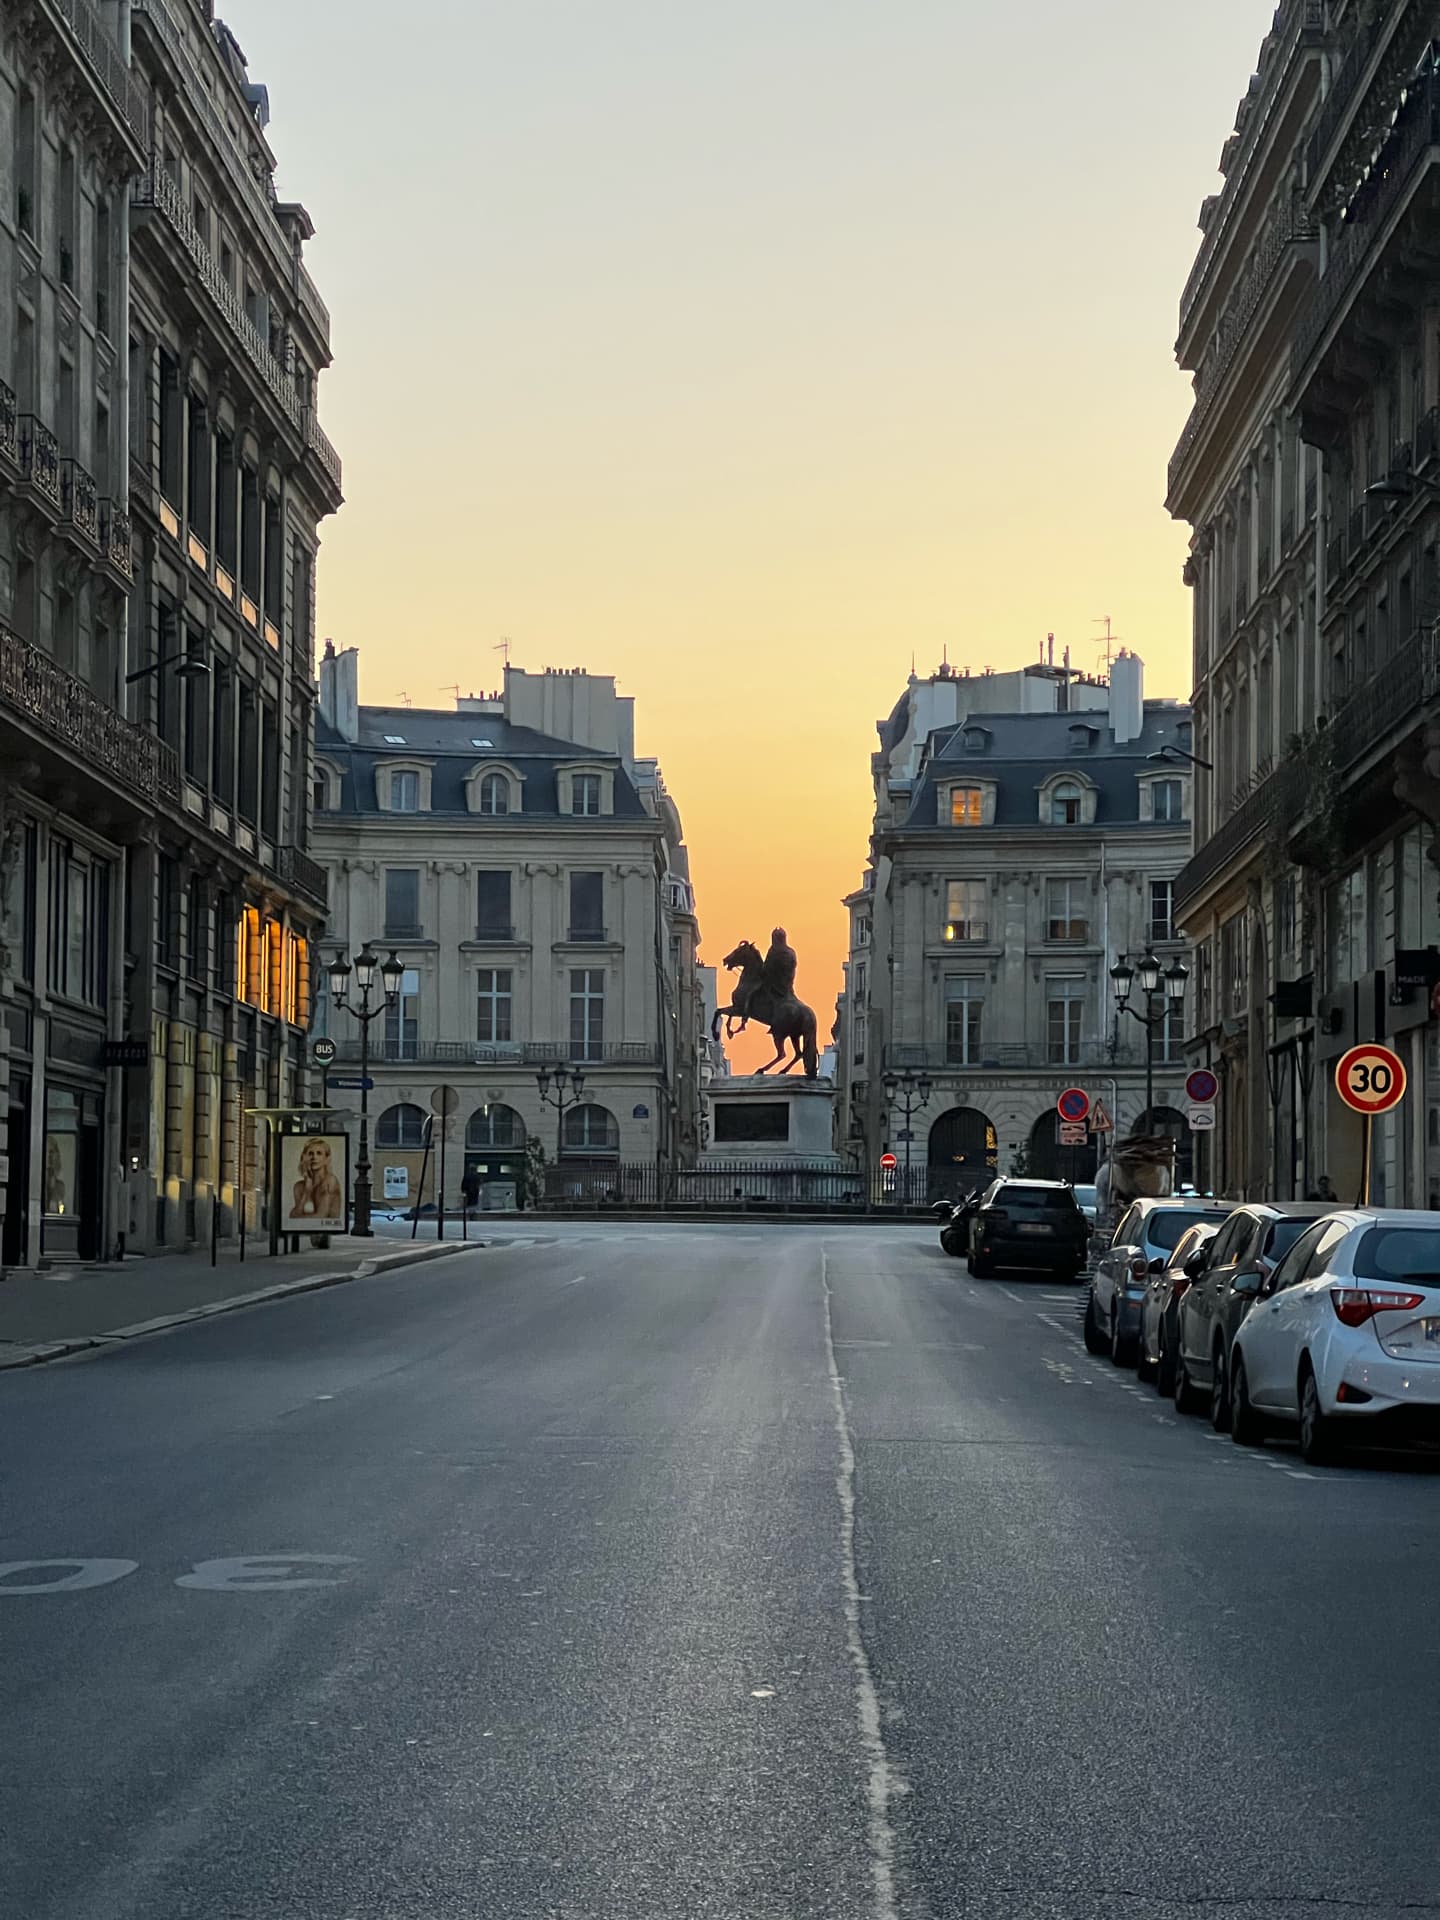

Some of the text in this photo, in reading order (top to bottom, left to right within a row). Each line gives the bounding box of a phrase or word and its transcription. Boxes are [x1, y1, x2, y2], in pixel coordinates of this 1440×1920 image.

[1399, 976, 1425, 984] MADE
[316, 1045, 333, 1054] BUS
[1352, 1065, 1391, 1094] 30
